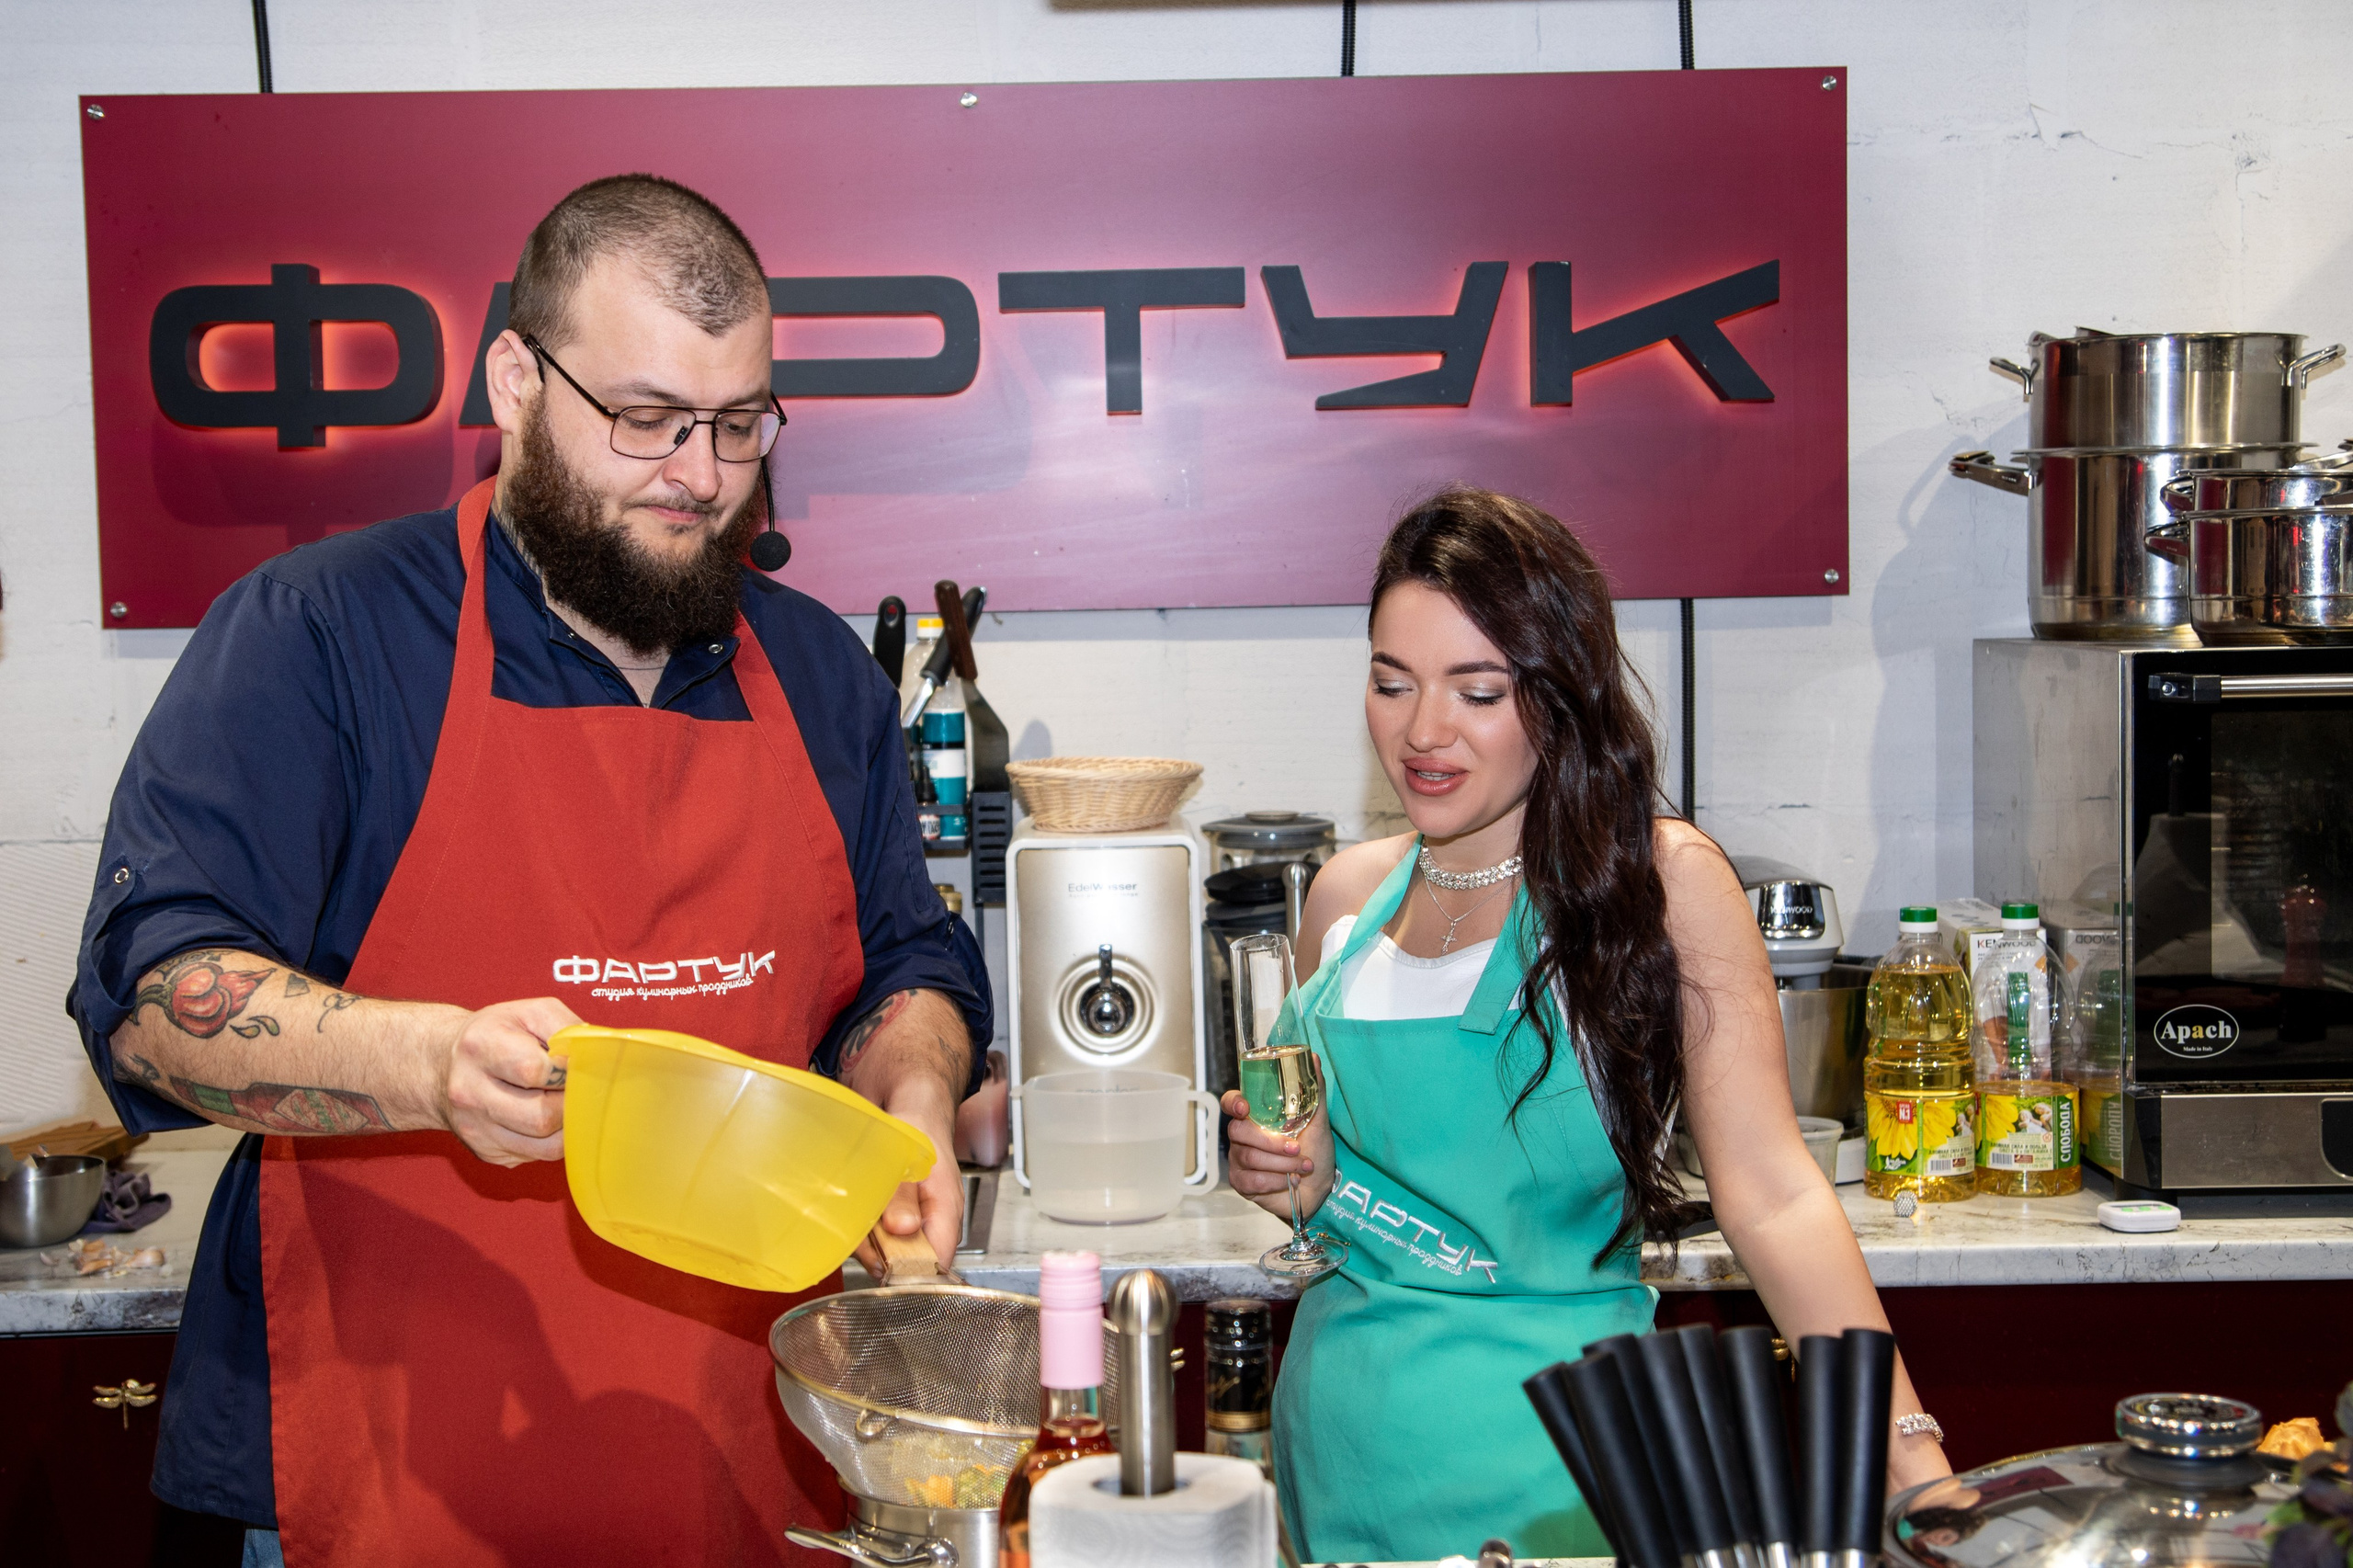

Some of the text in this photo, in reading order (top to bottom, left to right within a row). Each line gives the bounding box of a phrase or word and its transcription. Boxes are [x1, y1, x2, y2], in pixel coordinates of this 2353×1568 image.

[149, 258, 1780, 449] ФРТУК
[552, 949, 776, 984] ФАРТУК
[591, 973, 755, 1002] студия кулинарных праздников
[2160, 1020, 2233, 1044] Apach
[2060, 1101, 2071, 1163] СЛОБОДА
[1332, 1168, 1498, 1283] АРТУК
